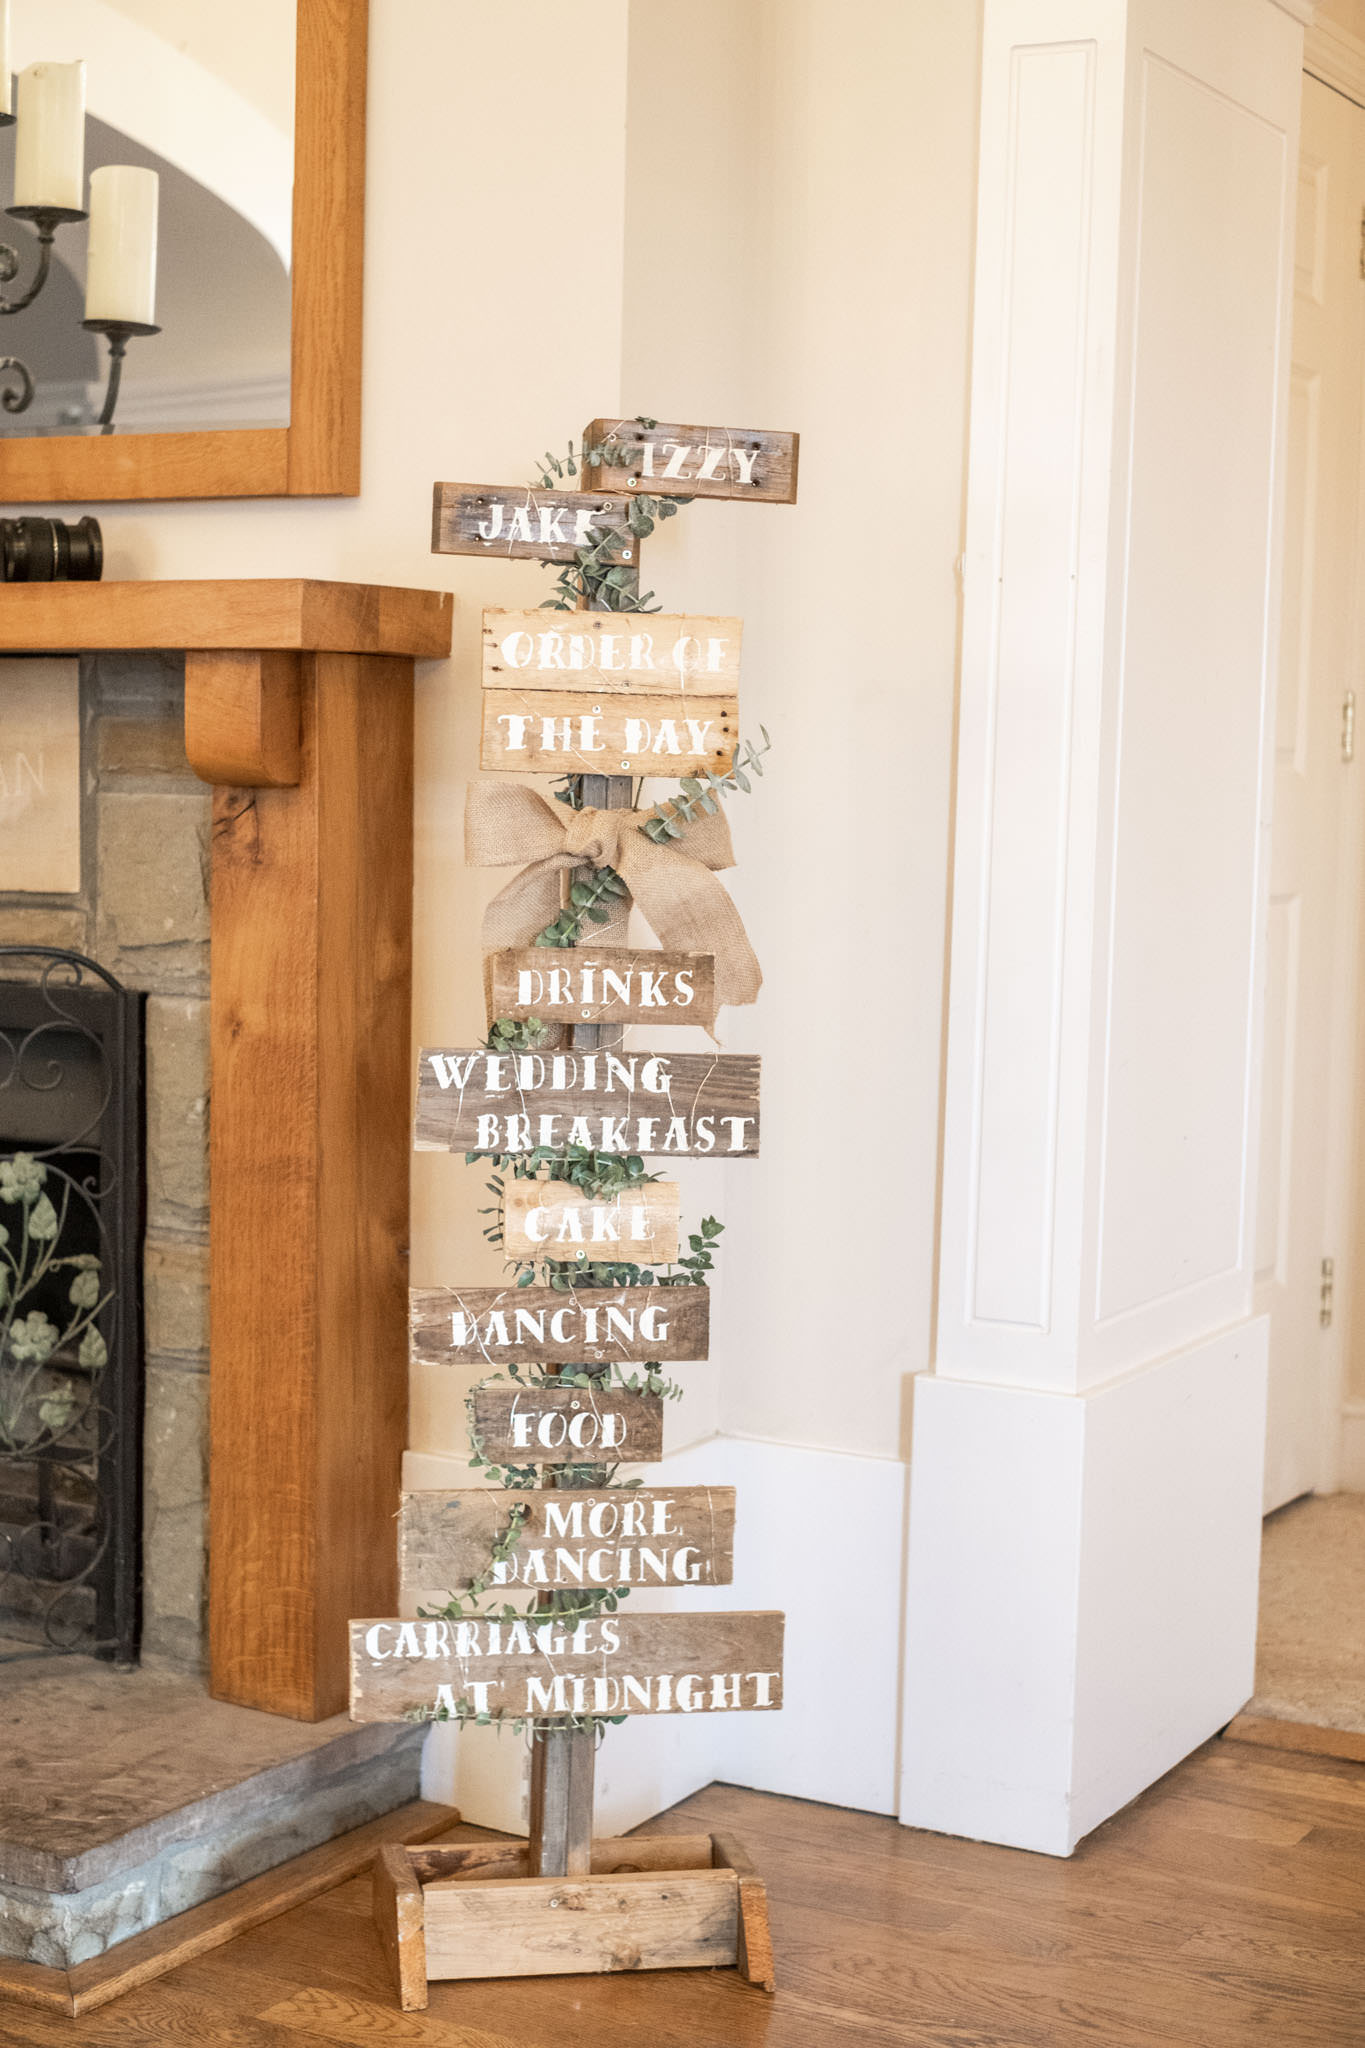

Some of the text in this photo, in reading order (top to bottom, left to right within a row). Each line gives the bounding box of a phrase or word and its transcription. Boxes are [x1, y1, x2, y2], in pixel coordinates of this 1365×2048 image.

[642, 442, 760, 484] IZZY
[479, 504, 606, 546] JAKE
[501, 631, 730, 672] ORDER OF
[497, 714, 715, 756] THE DAY
[515, 966, 695, 1007] DRINKS
[428, 1053, 673, 1093] WEDDING
[475, 1113, 755, 1152] BREAKFAST
[524, 1206, 656, 1243] CAKE
[448, 1306, 670, 1347] DANCING
[512, 1411, 627, 1449] FOOD
[543, 1500, 678, 1539] MORE
[490, 1546, 703, 1585] DANCING
[365, 1619, 621, 1660] CARRIAGES
[434, 1672, 780, 1716] AT MIDNIGHT
